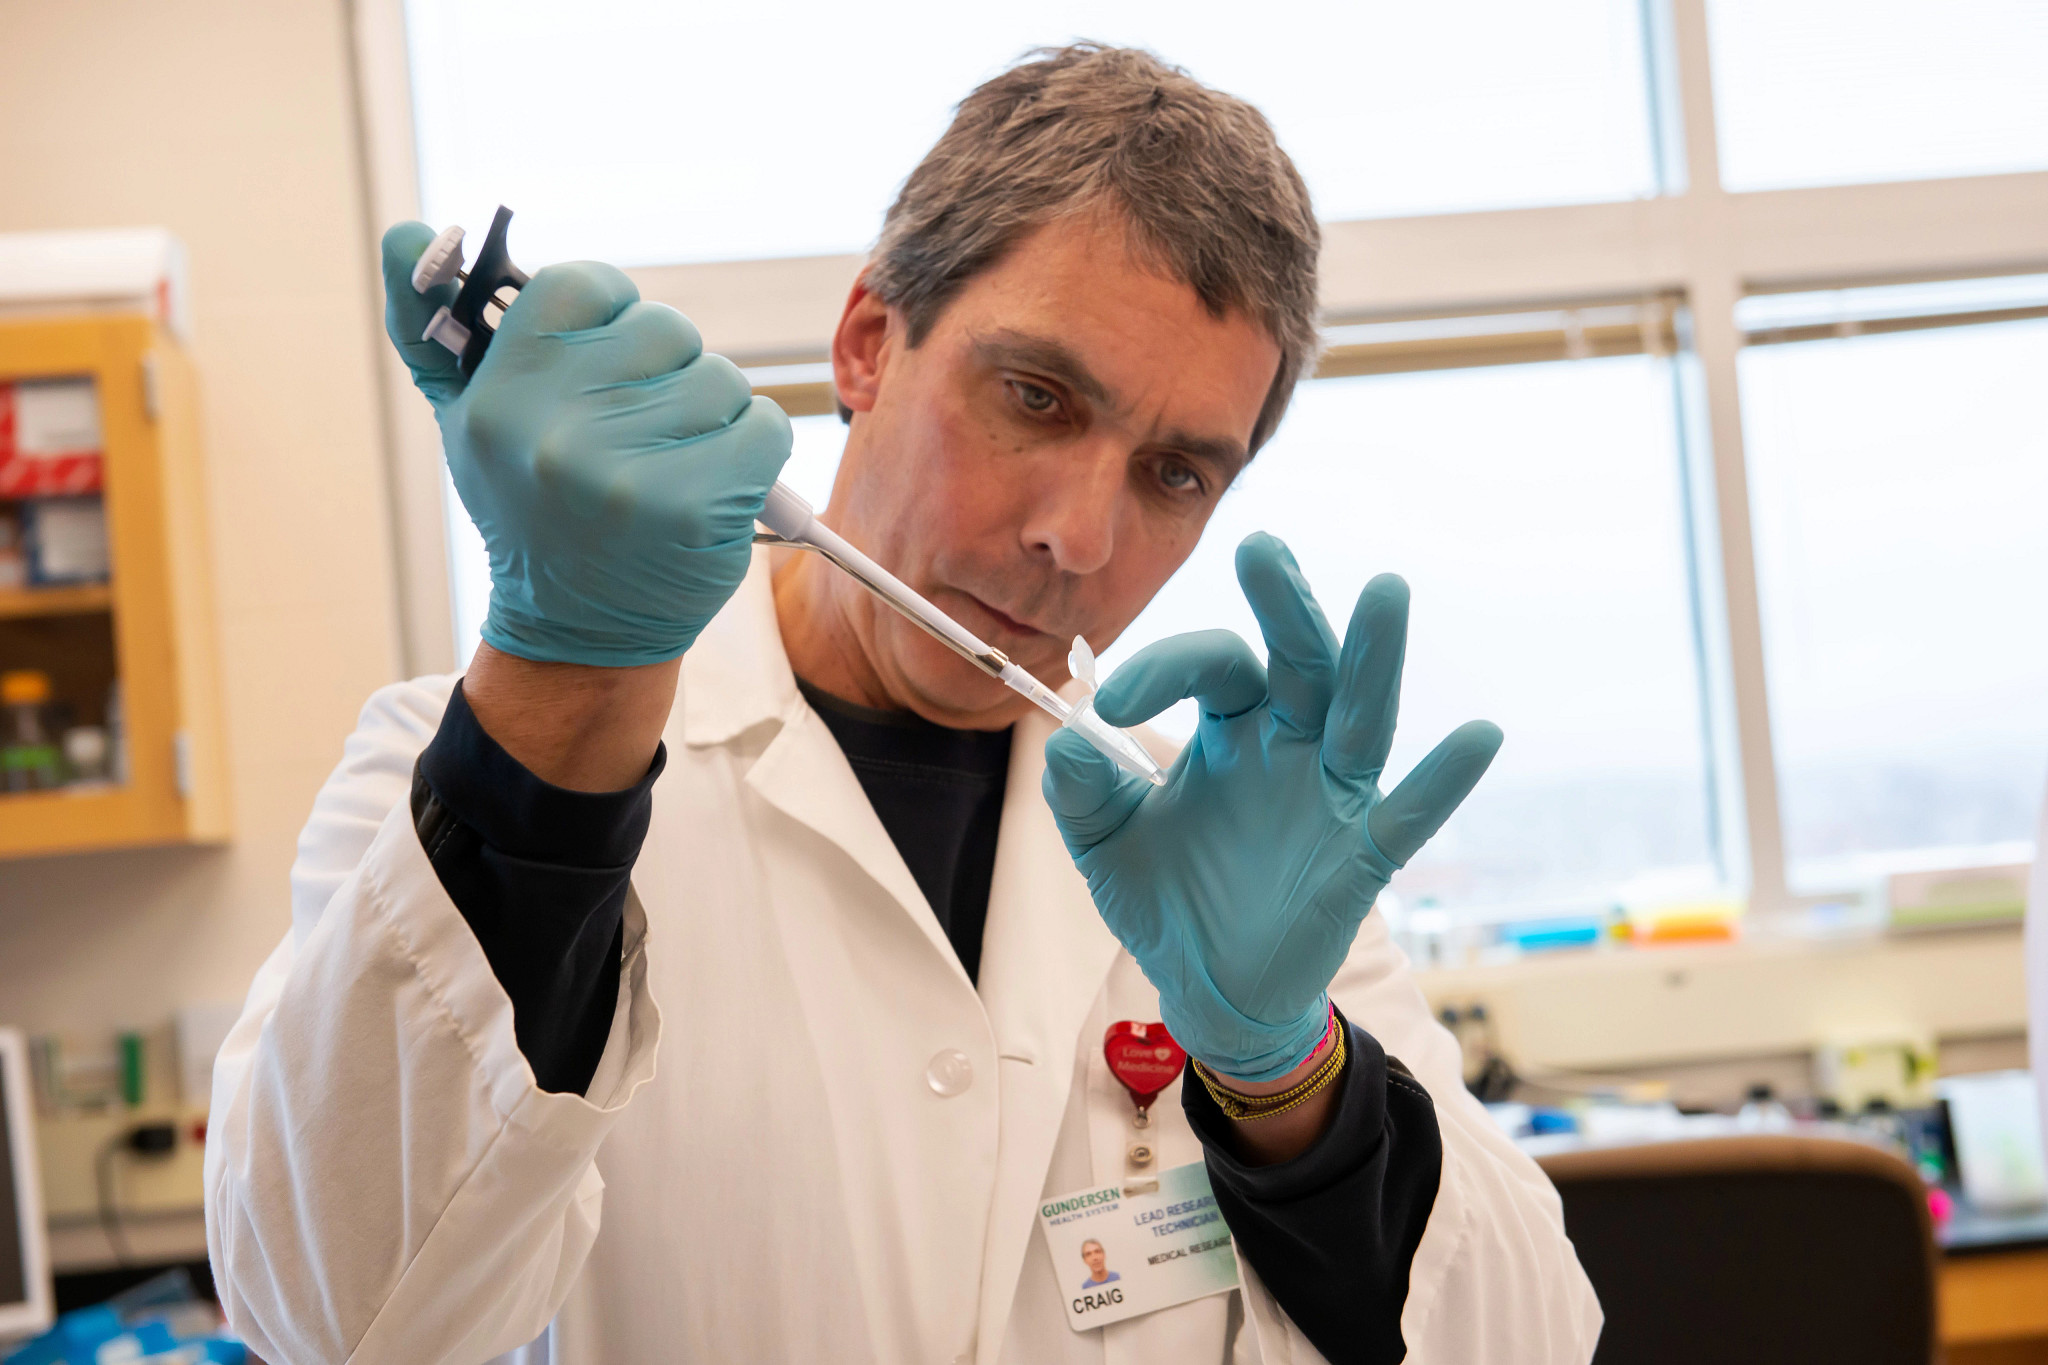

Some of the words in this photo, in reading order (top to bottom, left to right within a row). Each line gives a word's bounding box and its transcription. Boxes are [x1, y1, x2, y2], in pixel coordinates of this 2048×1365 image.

[1042, 1187, 1120, 1218] GUNDERSEN
[1049, 1213, 1083, 1227] HEALTH
[1085, 1203, 1119, 1217] SYSTEM
[1134, 1208, 1165, 1226] LEAD
[1152, 1210, 1219, 1237] TECHNICIAN
[1147, 1248, 1188, 1266] MEDICAL
[1072, 1288, 1124, 1314] CRAIG
